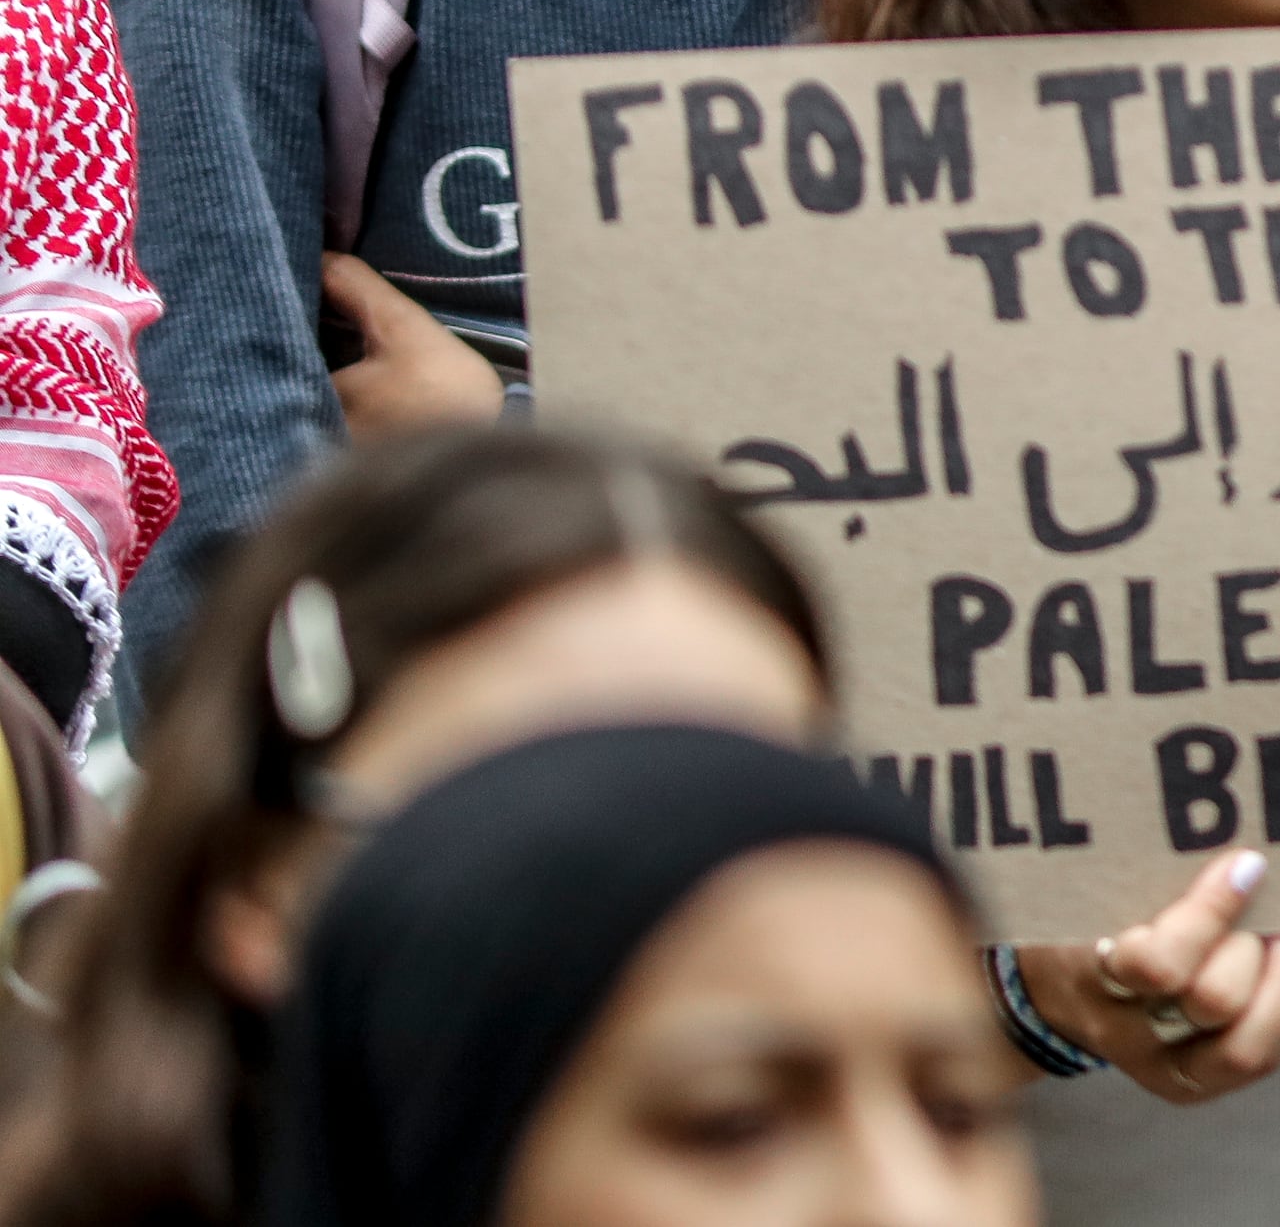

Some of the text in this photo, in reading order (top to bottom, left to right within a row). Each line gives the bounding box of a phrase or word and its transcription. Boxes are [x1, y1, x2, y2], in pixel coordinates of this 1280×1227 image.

[583, 78, 974, 228] FROM
[944, 220, 1148, 322] TO
[716, 350, 973, 541] البح
[1021, 349, 1238, 553] إلى
